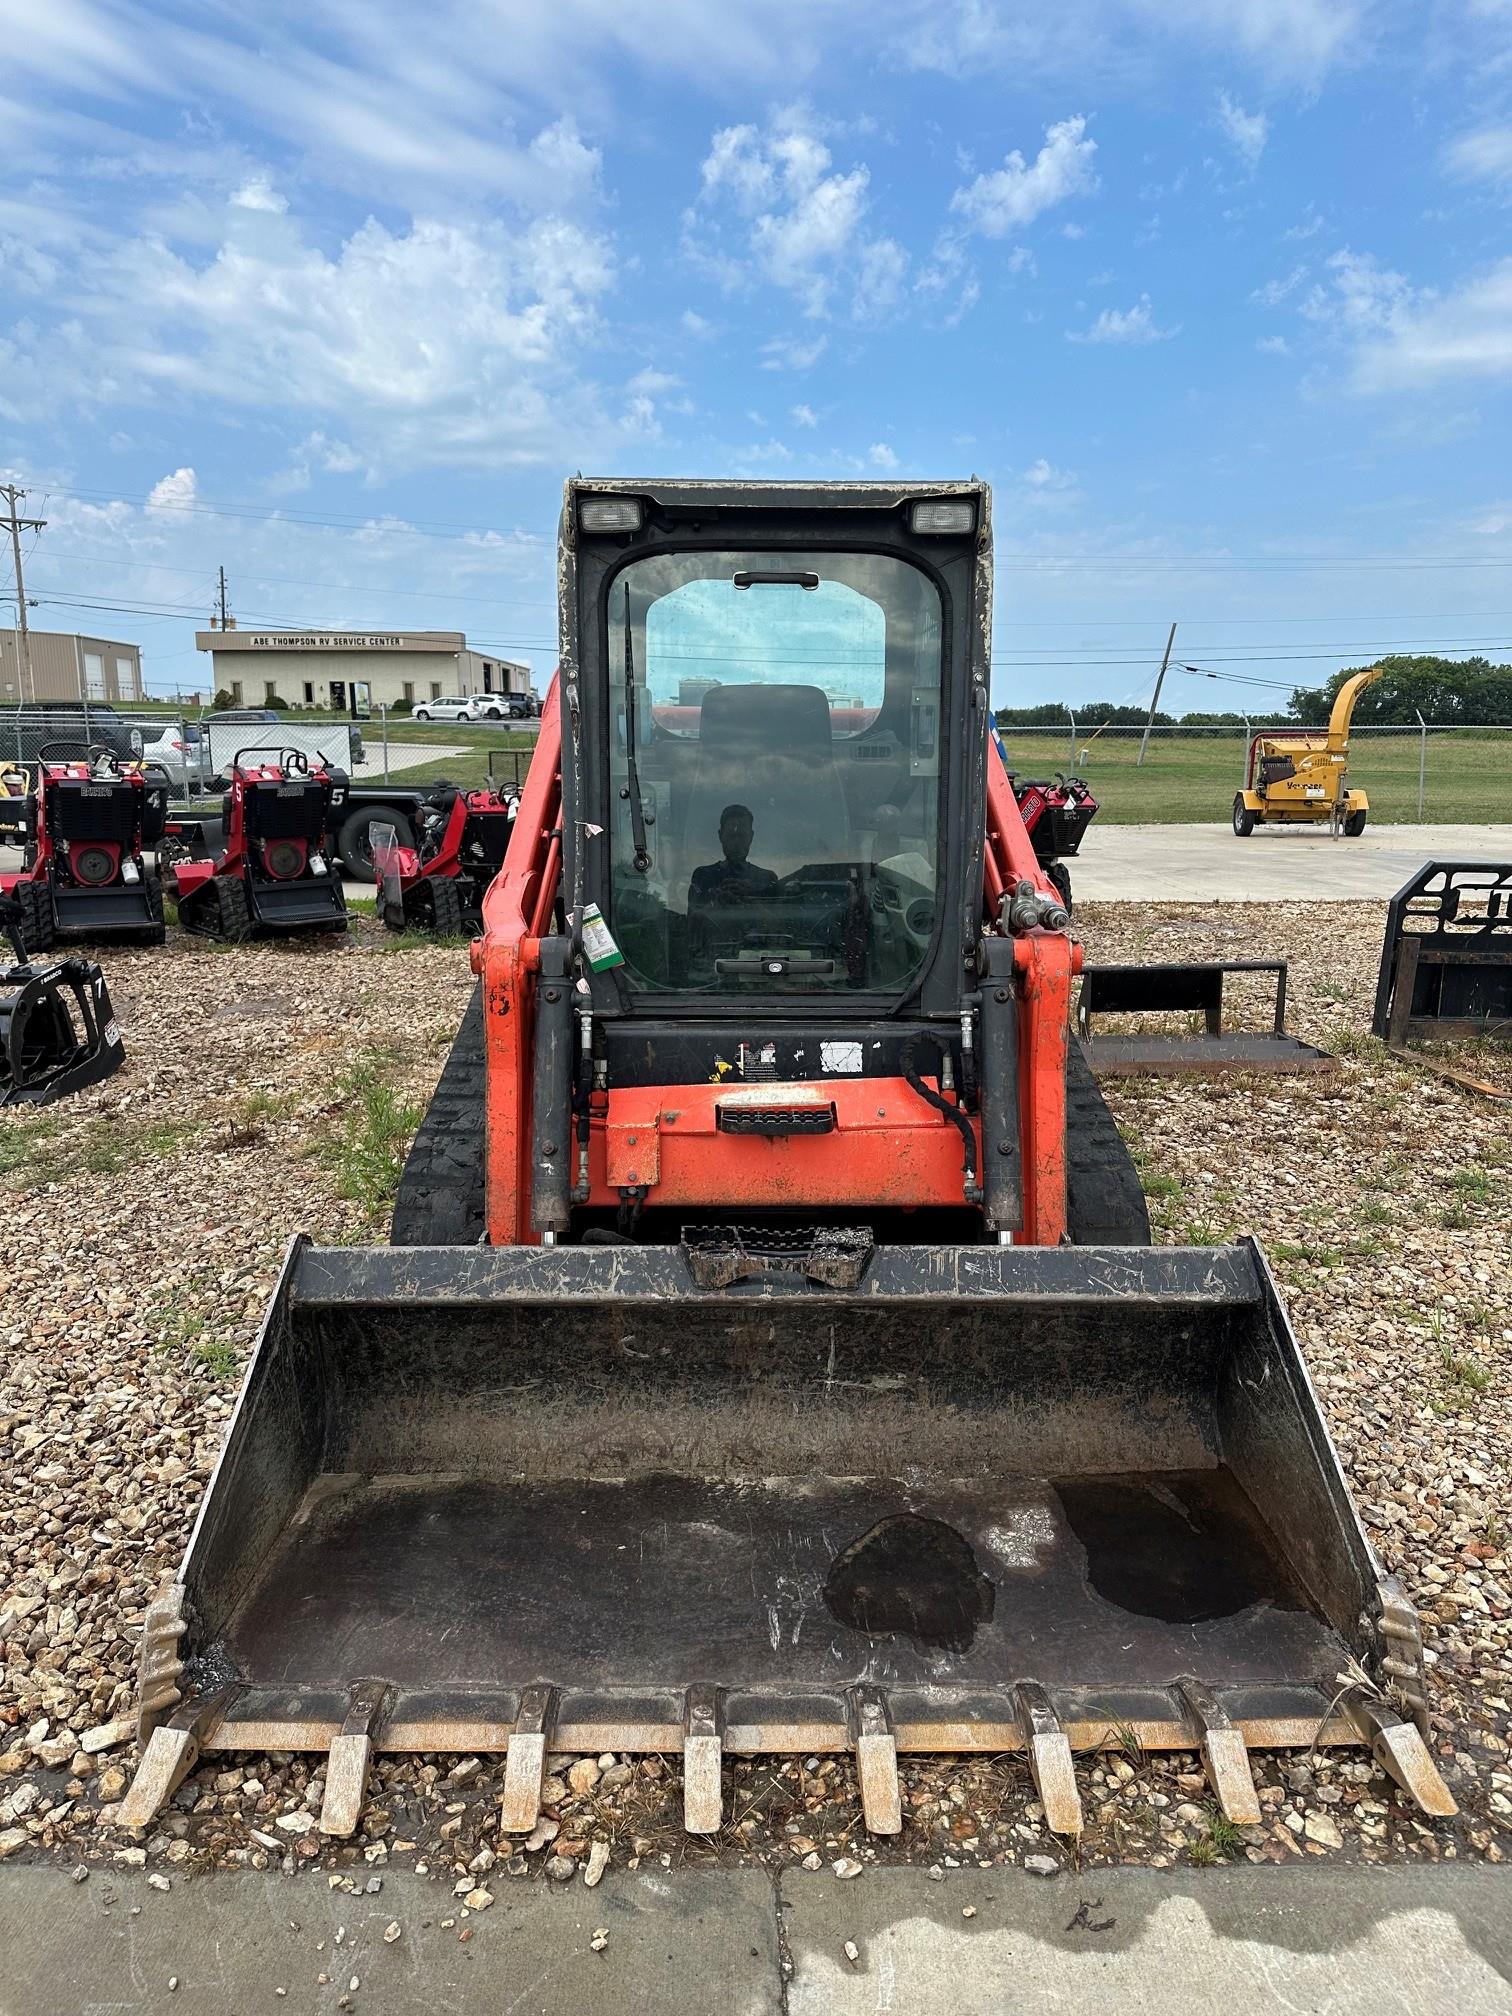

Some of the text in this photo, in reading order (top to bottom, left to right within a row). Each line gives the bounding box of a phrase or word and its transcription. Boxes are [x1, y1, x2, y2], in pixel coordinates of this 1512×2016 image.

[253, 637, 401, 646] ABE THOMPSON RV SERVICE CENTER
[331, 788, 345, 805] 5
